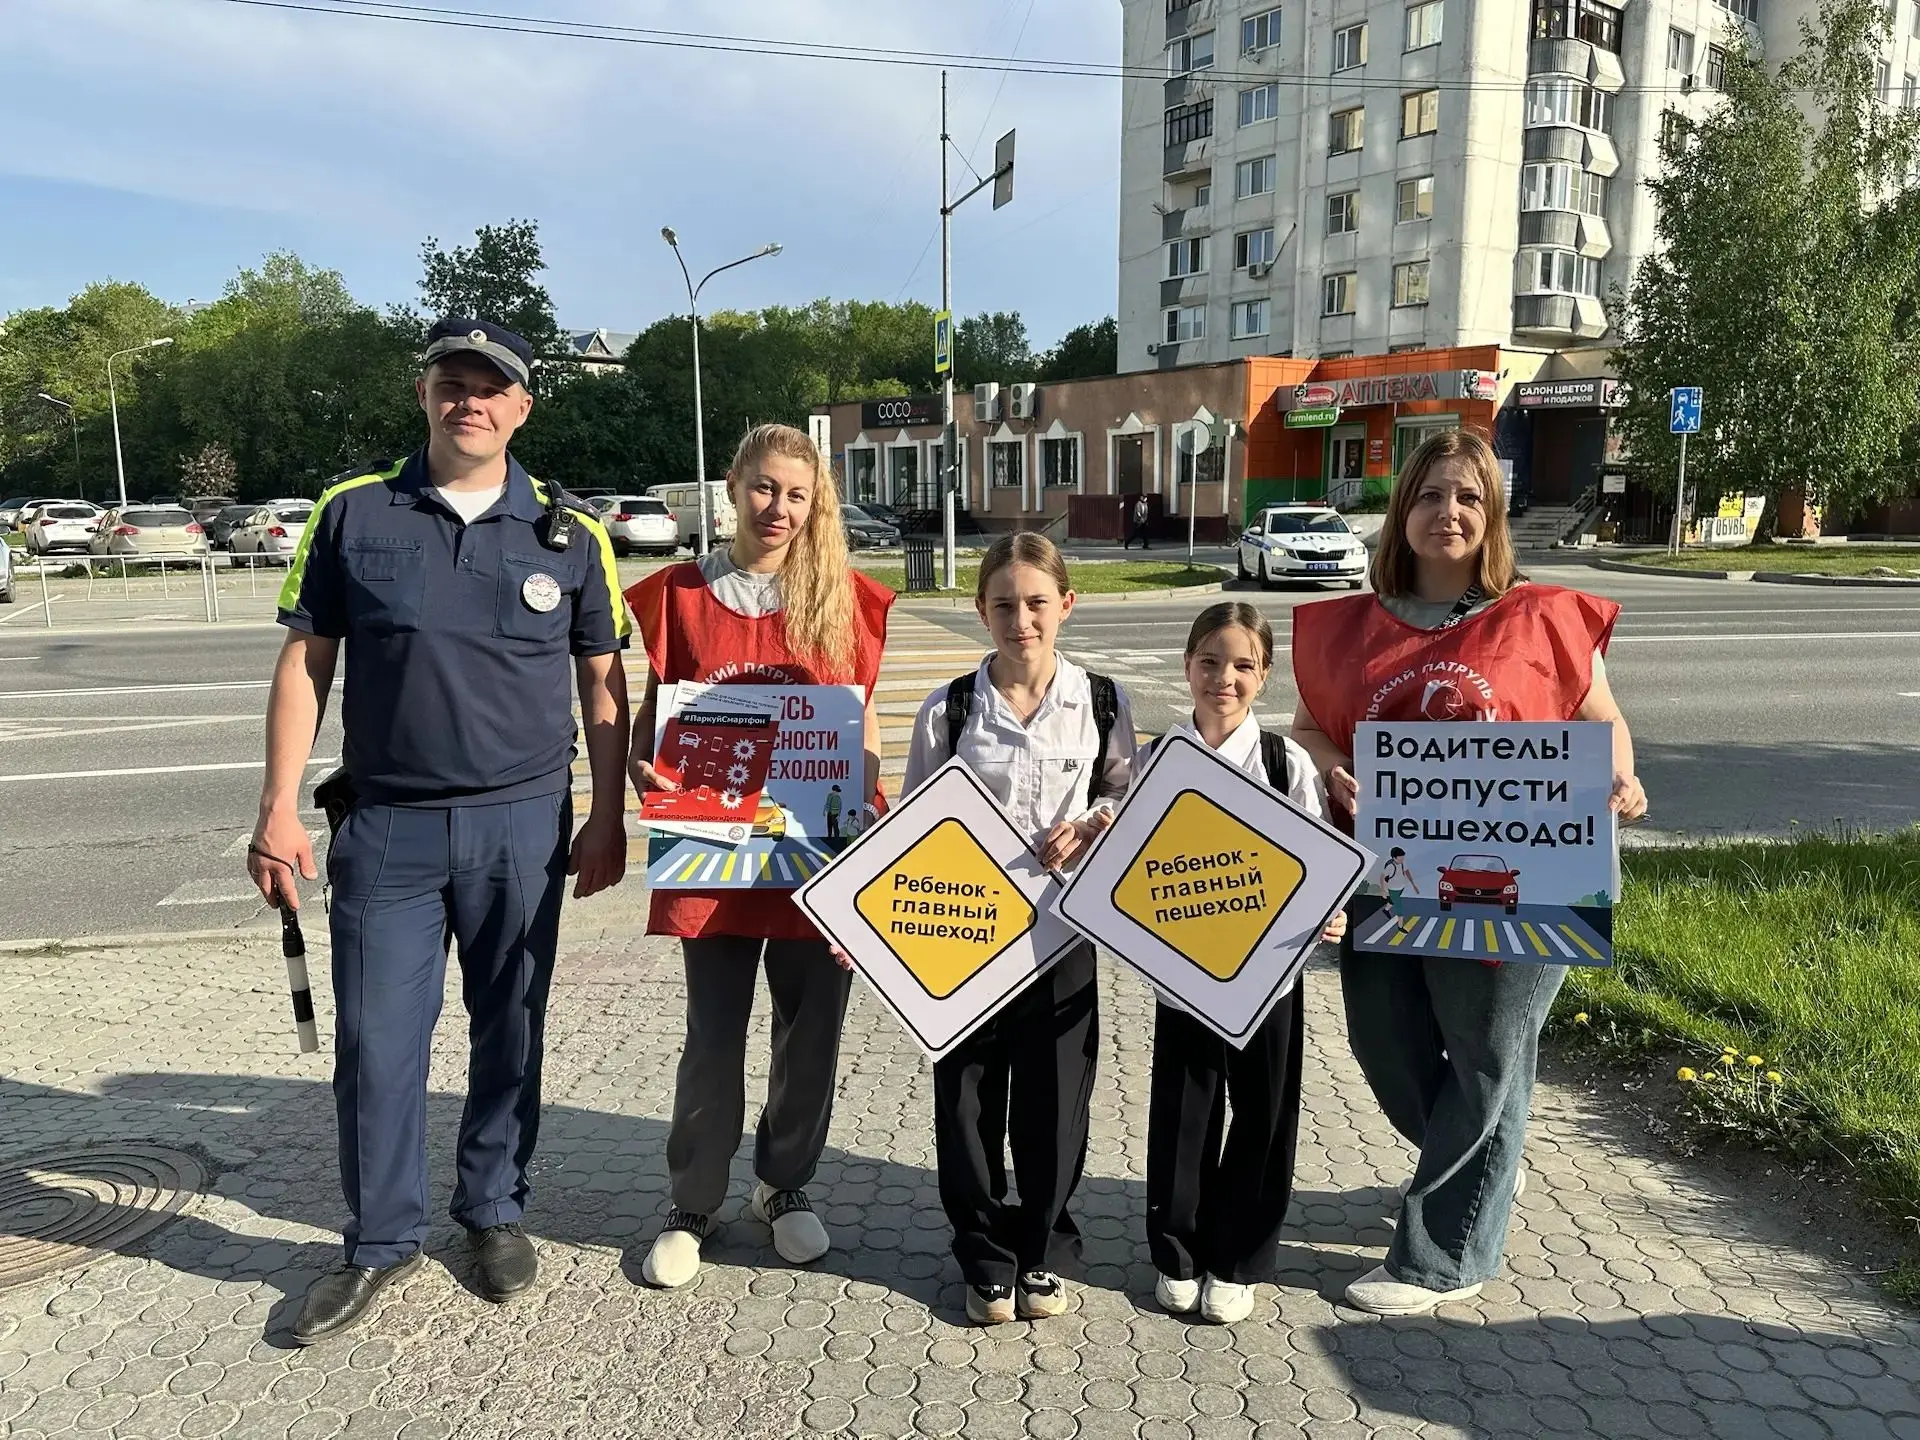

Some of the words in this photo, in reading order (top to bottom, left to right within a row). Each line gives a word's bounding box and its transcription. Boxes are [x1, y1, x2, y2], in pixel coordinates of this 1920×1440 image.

[1340, 374, 1438, 403] АПТЕКА
[1520, 386, 1553, 396] САЛОН
[1554, 383, 1594, 395] ЦВЕТОВ
[1551, 395, 1593, 404] ПОДАРКОВ
[1288, 412, 1334, 423] farmlend.ru
[1716, 518, 1745, 535] ОБУВЬ
[1292, 535, 1342, 543] ДПС
[744, 662, 799, 685] ПАТРУ
[1422, 661, 1494, 699] ПАТРУЛЬ
[683, 714, 766, 725] #ПаркуйСмартфон
[1376, 730, 1570, 762] Водитель!
[768, 760, 849, 782] ЕХОДОМ!
[1376, 771, 1567, 807] Пропусти
[648, 812, 746, 822] #БезопасныеДорогиДетям
[1375, 816, 1594, 847] пешехода!
[1145, 850, 1244, 879] Ребенок
[894, 873, 986, 898] Ребенок
[1150, 866, 1262, 901] главный
[892, 899, 997, 920] главный
[1155, 889, 1267, 923] пешеход!
[891, 920, 995, 944] пешеход!
